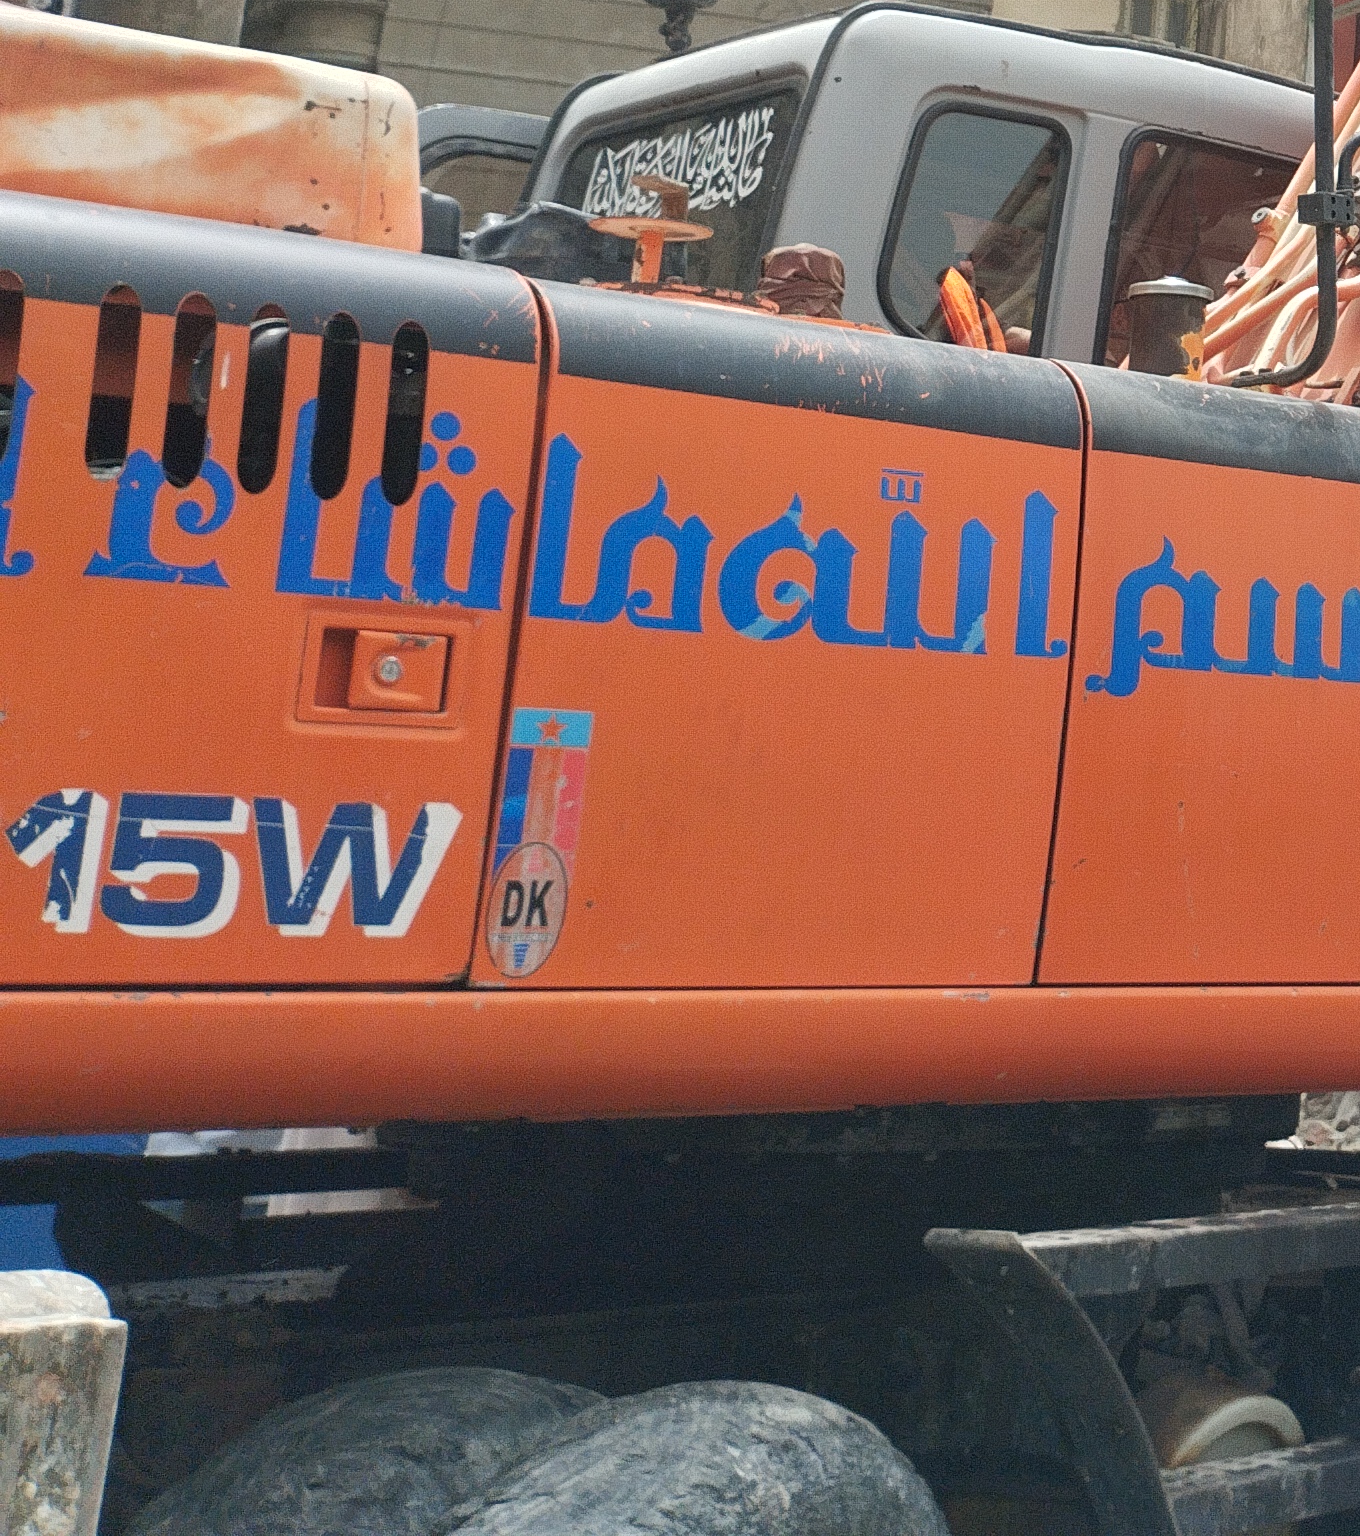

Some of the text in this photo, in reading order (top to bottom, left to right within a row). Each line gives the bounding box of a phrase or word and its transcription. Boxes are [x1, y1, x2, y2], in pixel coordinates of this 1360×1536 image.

[527, 431, 717, 634] ما
[716, 466, 1071, 659] الله
[3, 787, 465, 939] 15W
[500, 879, 554, 927] DK
